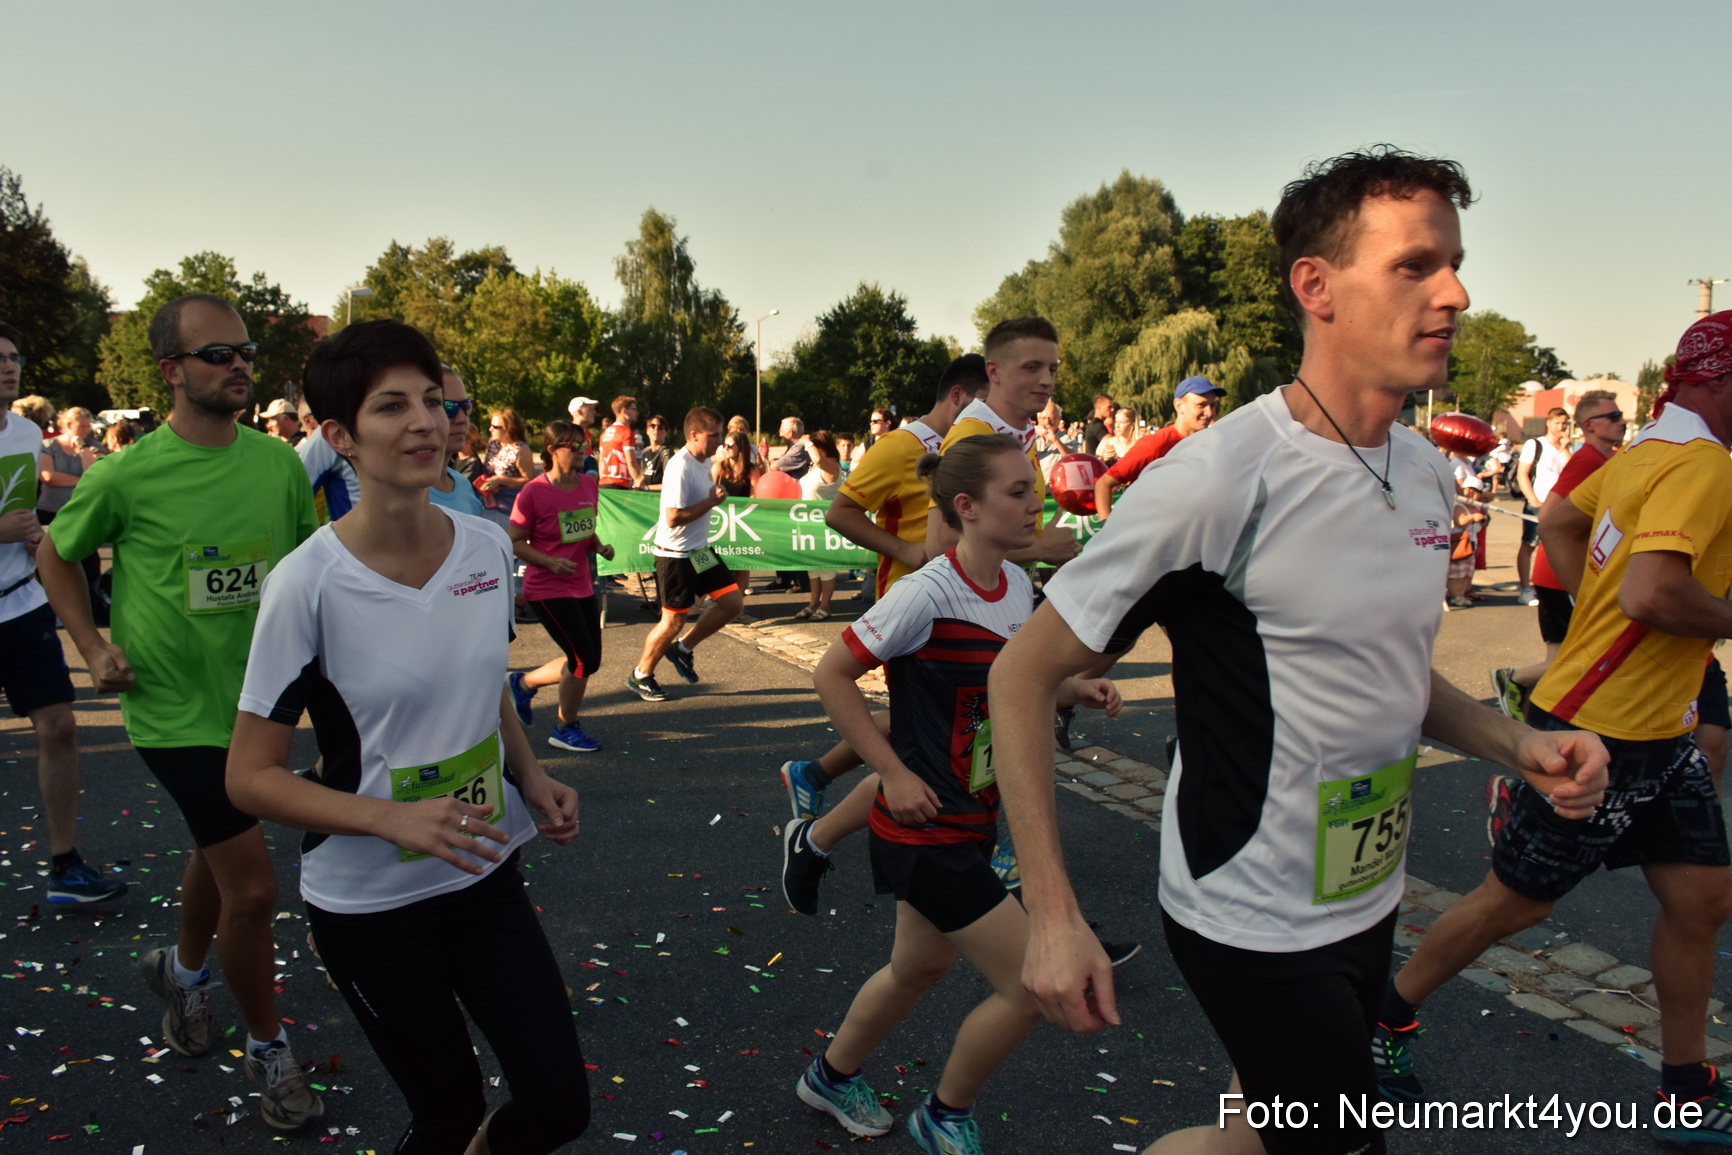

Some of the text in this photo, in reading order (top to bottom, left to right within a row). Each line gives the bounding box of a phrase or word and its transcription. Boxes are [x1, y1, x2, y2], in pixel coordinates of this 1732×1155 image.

[565, 518, 594, 534] 2063
[791, 529, 815, 551] in
[206, 564, 258, 595] 624
[469, 570, 487, 580] TEAM
[460, 577, 499, 596] partner
[206, 594, 235, 603] Hustafa
[1352, 797, 1409, 863] 755
